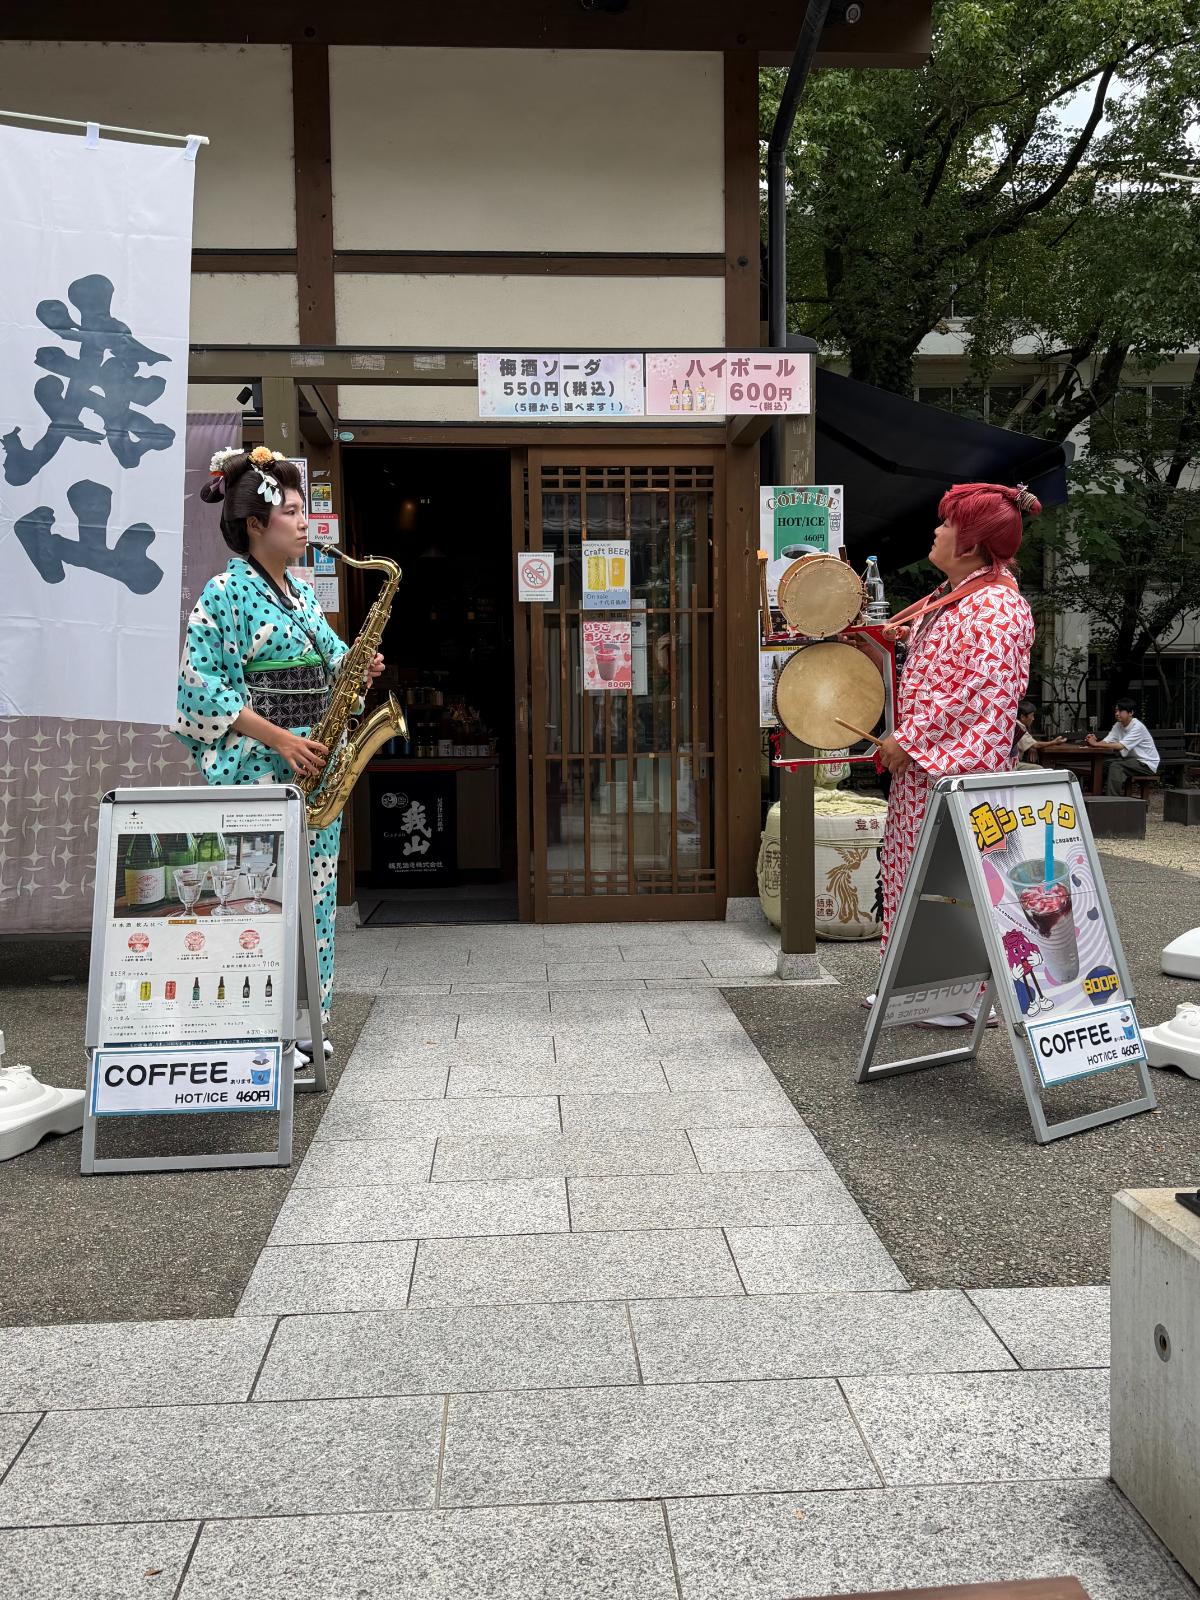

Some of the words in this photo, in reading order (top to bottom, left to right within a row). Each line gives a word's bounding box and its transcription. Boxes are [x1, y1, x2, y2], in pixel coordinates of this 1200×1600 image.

[499, 358, 602, 377] 梅酒ソーダ
[686, 358, 796, 378] ハイボール
[503, 381, 615, 397] 550円(税込)
[729, 383, 792, 401] 600円
[766, 491, 839, 511] COFFEE
[777, 516, 826, 527] HOT/ICE
[804, 534, 825, 542] 460円
[584, 548, 606, 557] Craft
[608, 548, 629, 557] BEER
[584, 623, 609, 631] いちご
[584, 633, 630, 641] 酒シェイク
[970, 800, 1077, 851] 酒シェイク
[1083, 970, 1120, 996] 800円
[1039, 1022, 1113, 1058] COFFEE
[1086, 1049, 1119, 1065] HOT/ICE
[1121, 1043, 1141, 1057] 460円
[104, 1061, 228, 1088] COFFEE
[175, 1092, 228, 1104] HOT/ICE
[236, 1090, 270, 1103] 460円
